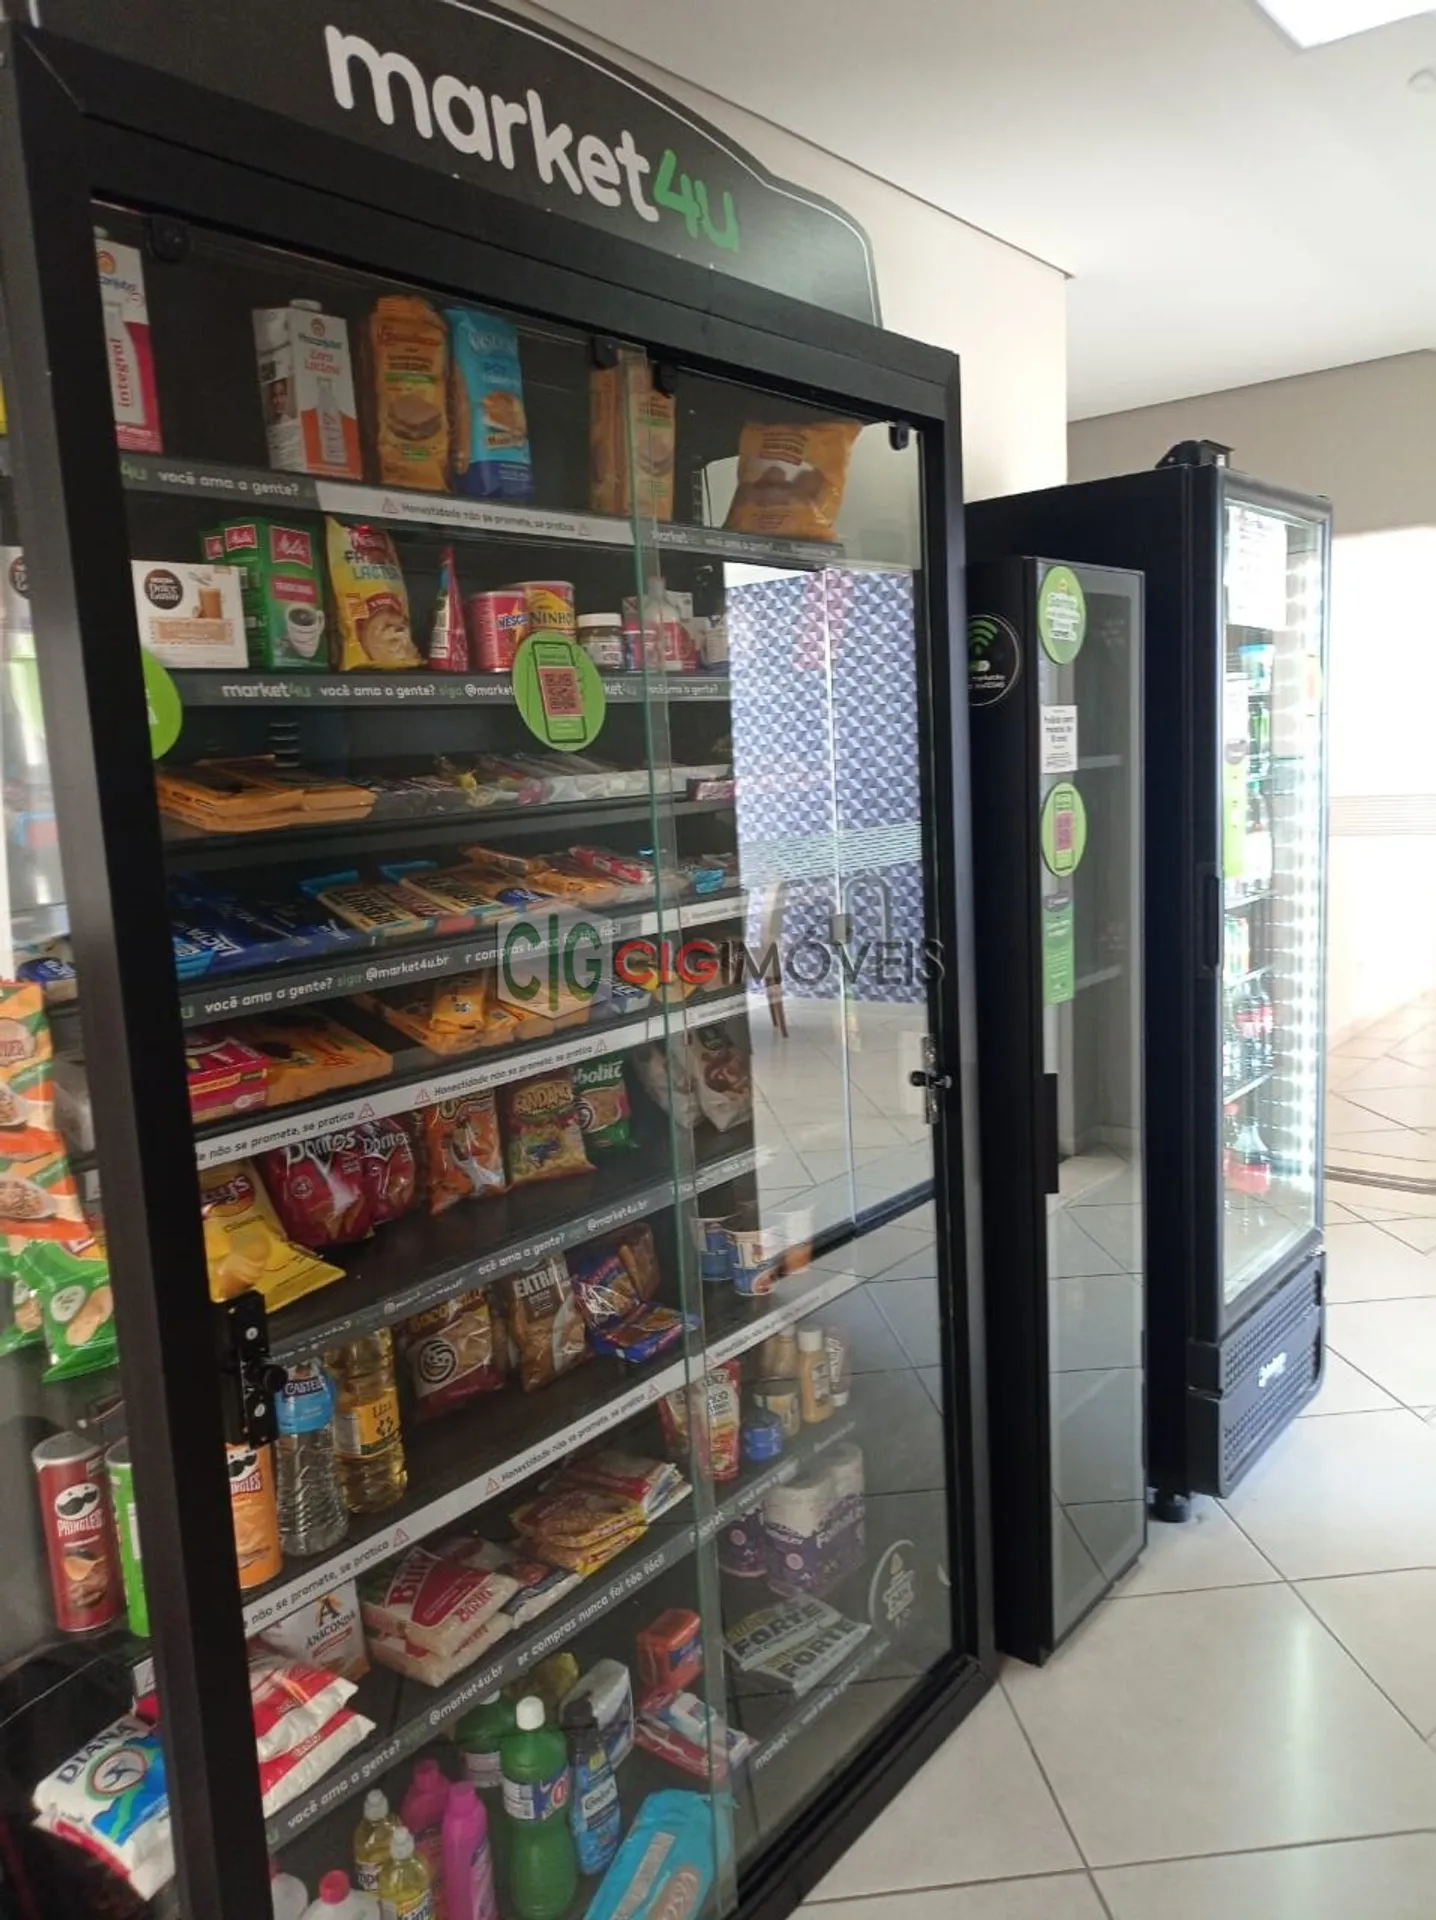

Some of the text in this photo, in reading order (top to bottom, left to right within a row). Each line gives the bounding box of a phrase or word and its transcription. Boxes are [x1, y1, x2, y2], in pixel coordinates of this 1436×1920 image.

[324, 26, 740, 252] market4u
[158, 471, 196, 484] você
[199, 476, 234, 489] ama
[238, 481, 248, 491] a
[252, 482, 299, 496] gente?
[222, 682, 311, 698] market4u
[320, 684, 350, 696] você
[353, 686, 382, 696] ama
[385, 686, 393, 696] a
[396, 684, 436, 698] gente?
[204, 996, 238, 1013] você
[242, 992, 272, 1006] ama
[276, 988, 285, 999] a
[289, 978, 333, 999] gente?
[56, 1720, 139, 1786] DIANA
[287, 1800, 318, 1829] você
[319, 1780, 349, 1805] ama
[361, 1739, 401, 1778] gente?
